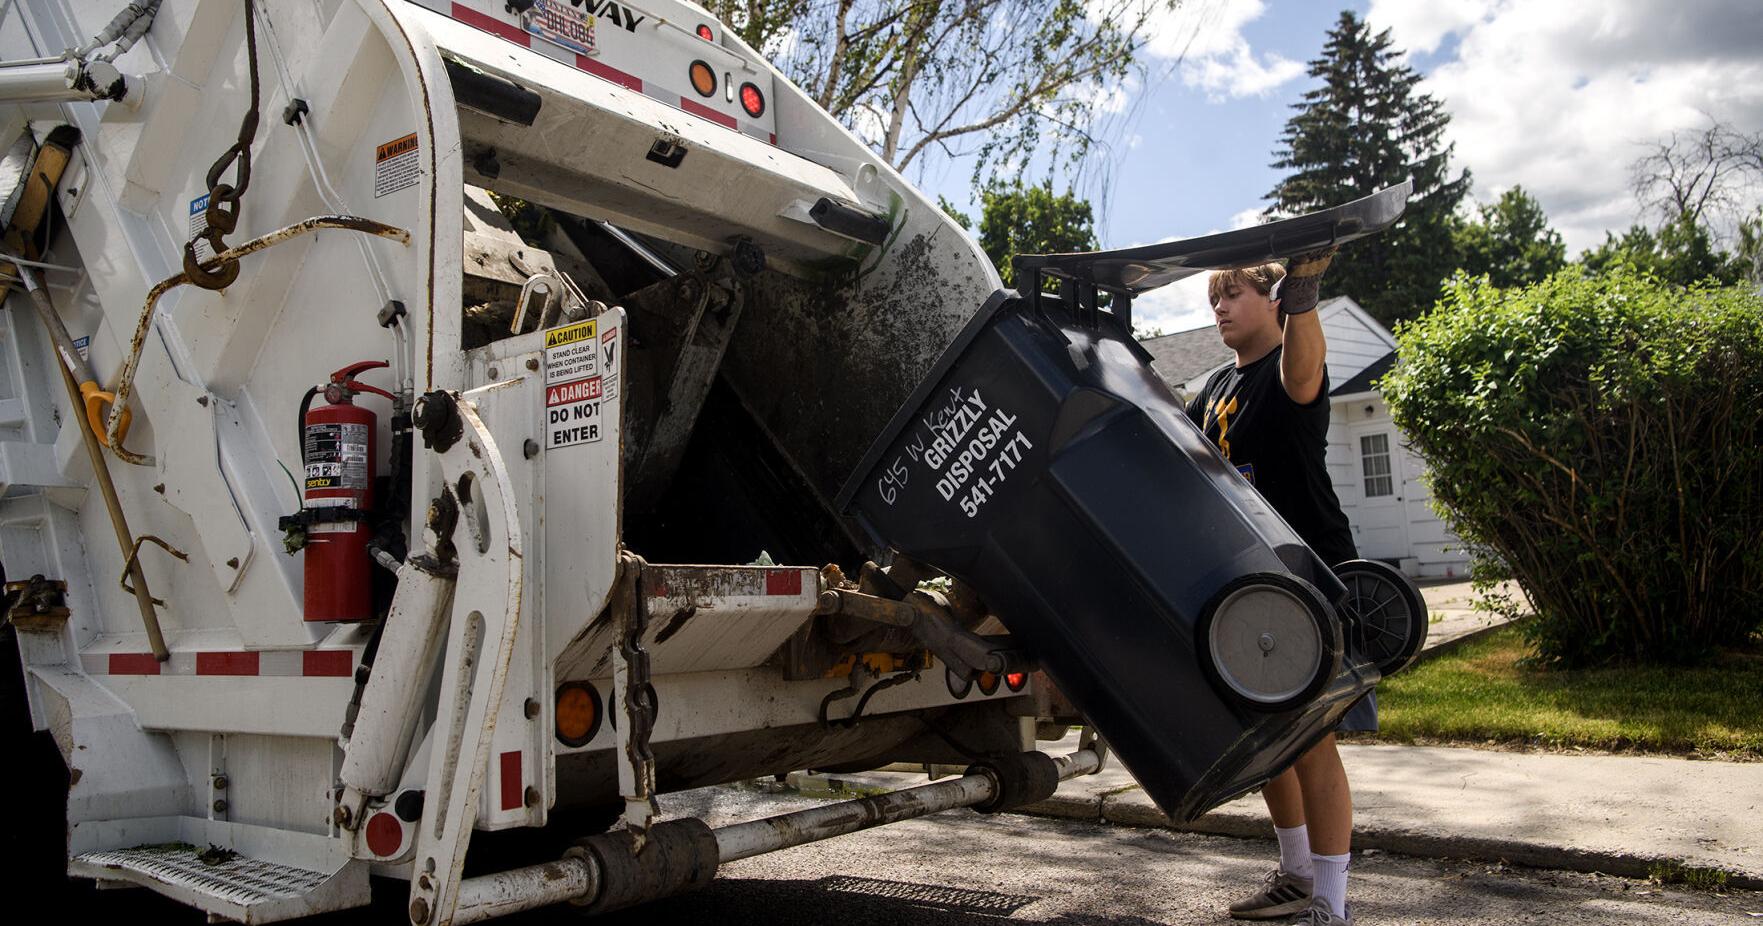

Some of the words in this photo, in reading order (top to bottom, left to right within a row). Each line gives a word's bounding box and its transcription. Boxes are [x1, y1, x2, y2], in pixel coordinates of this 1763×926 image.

[193, 198, 208, 212] NOT
[557, 325, 593, 344] CAUTION
[547, 360, 563, 370] WHEN
[564, 353, 596, 366] CONTAINER
[552, 349, 570, 359] STAND
[571, 345, 590, 355] CLEAR
[556, 367, 573, 377] BEING
[574, 363, 593, 373] LIFTED
[560, 379, 601, 402] DANGER
[550, 408, 569, 424] DO
[574, 402, 600, 420] NOT
[554, 424, 598, 445] ENTER
[924, 388, 987, 470] GRIZZLY
[935, 408, 1017, 502] DISPOSAL
[878, 455, 909, 506] 645
[905, 432, 924, 462] W
[959, 430, 1033, 518] 541-7171
[307, 478, 331, 488] sentry
